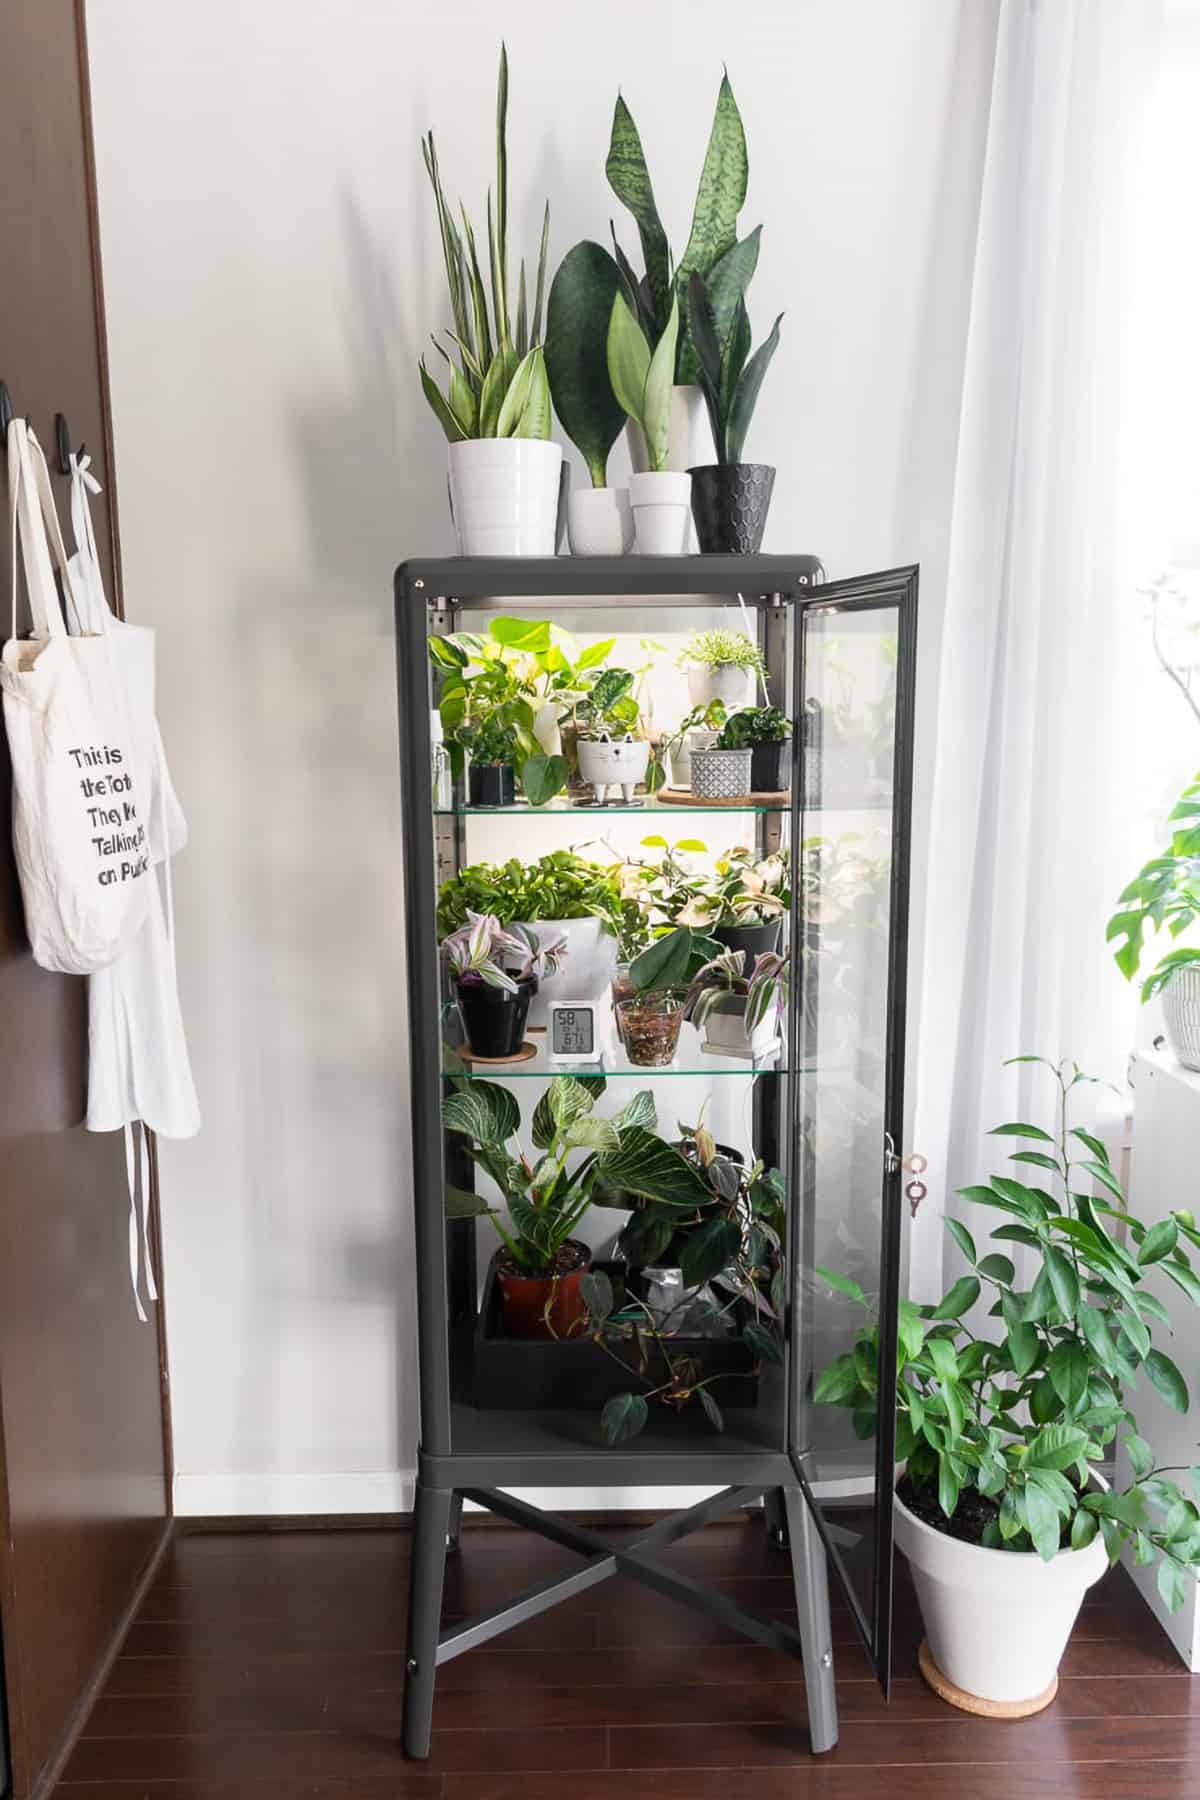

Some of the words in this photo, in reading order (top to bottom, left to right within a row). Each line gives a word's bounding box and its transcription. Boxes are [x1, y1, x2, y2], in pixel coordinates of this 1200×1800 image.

[68, 746, 103, 768] This
[104, 745, 122, 765] is
[105, 773, 132, 794] Tot
[87, 806, 122, 827] They
[559, 1011, 575, 1025] 58
